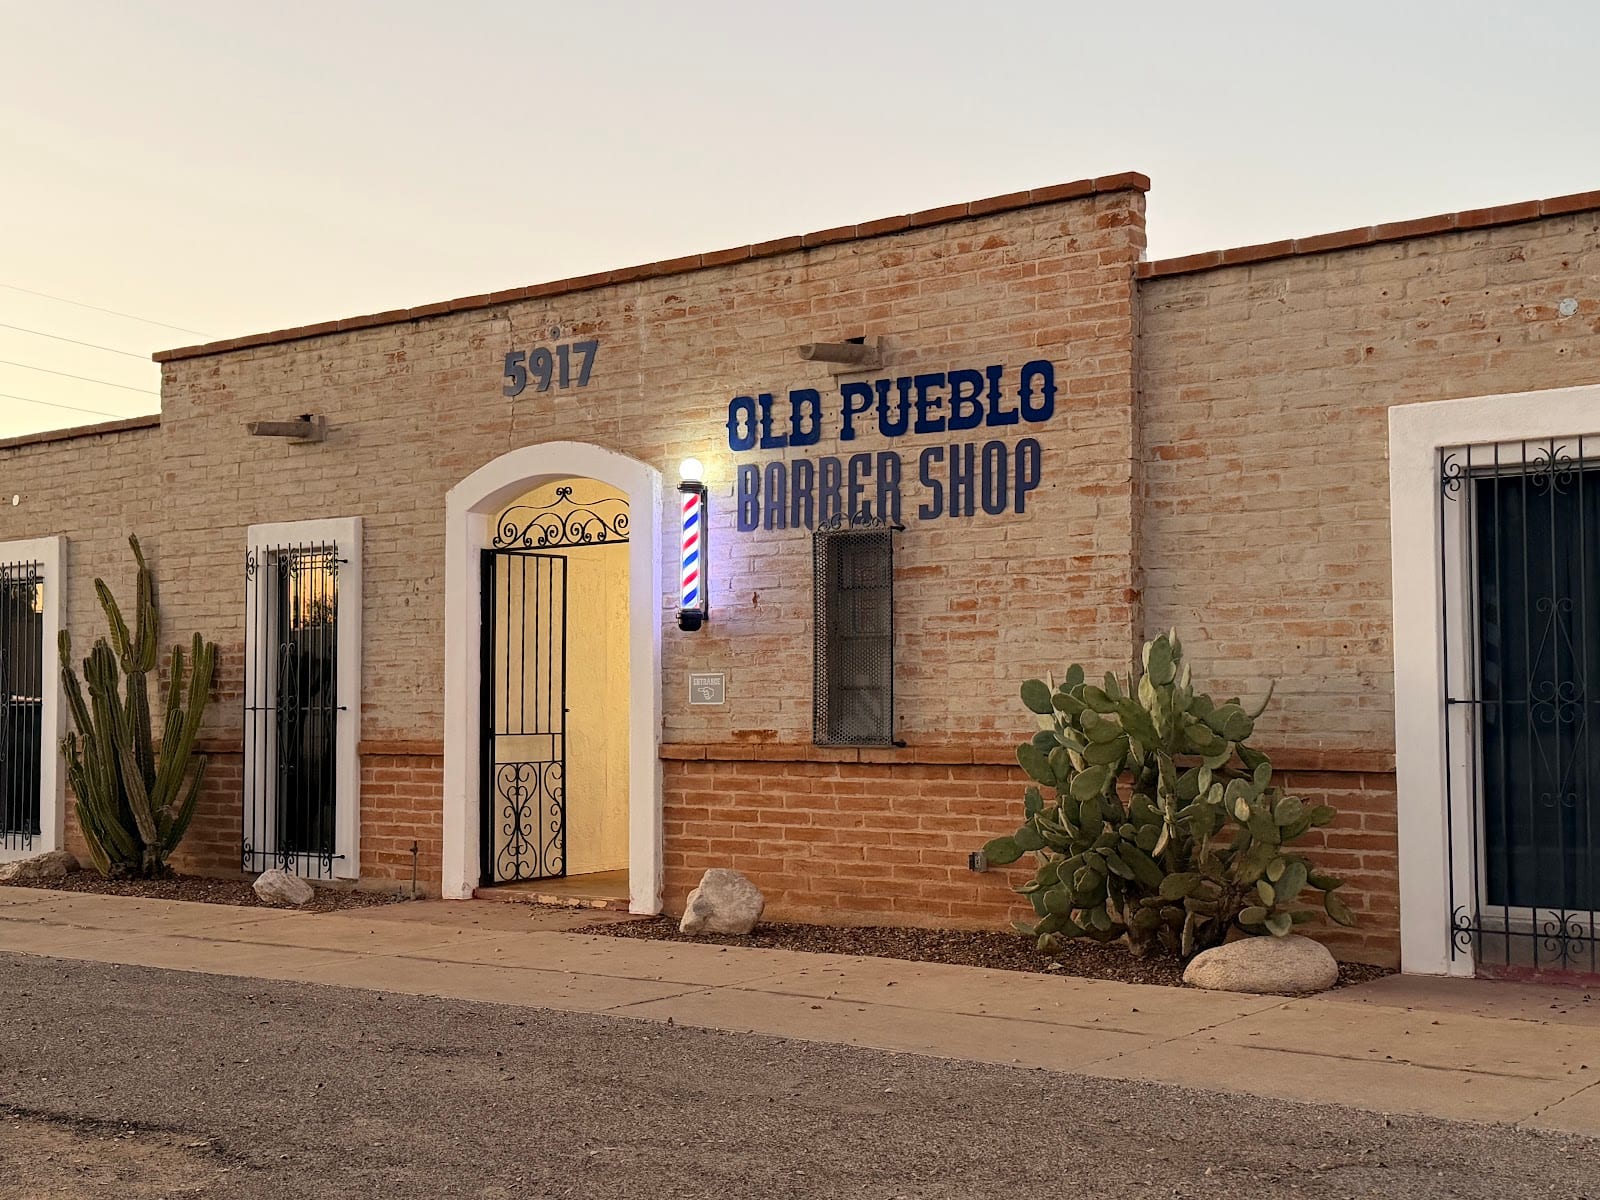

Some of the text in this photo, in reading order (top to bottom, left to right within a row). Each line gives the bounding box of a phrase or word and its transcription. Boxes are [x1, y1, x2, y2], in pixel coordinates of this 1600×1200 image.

[503, 340, 598, 397] 5917
[726, 360, 1057, 451] OLD PUEBLO
[737, 438, 1041, 532] BARBER SHOP
